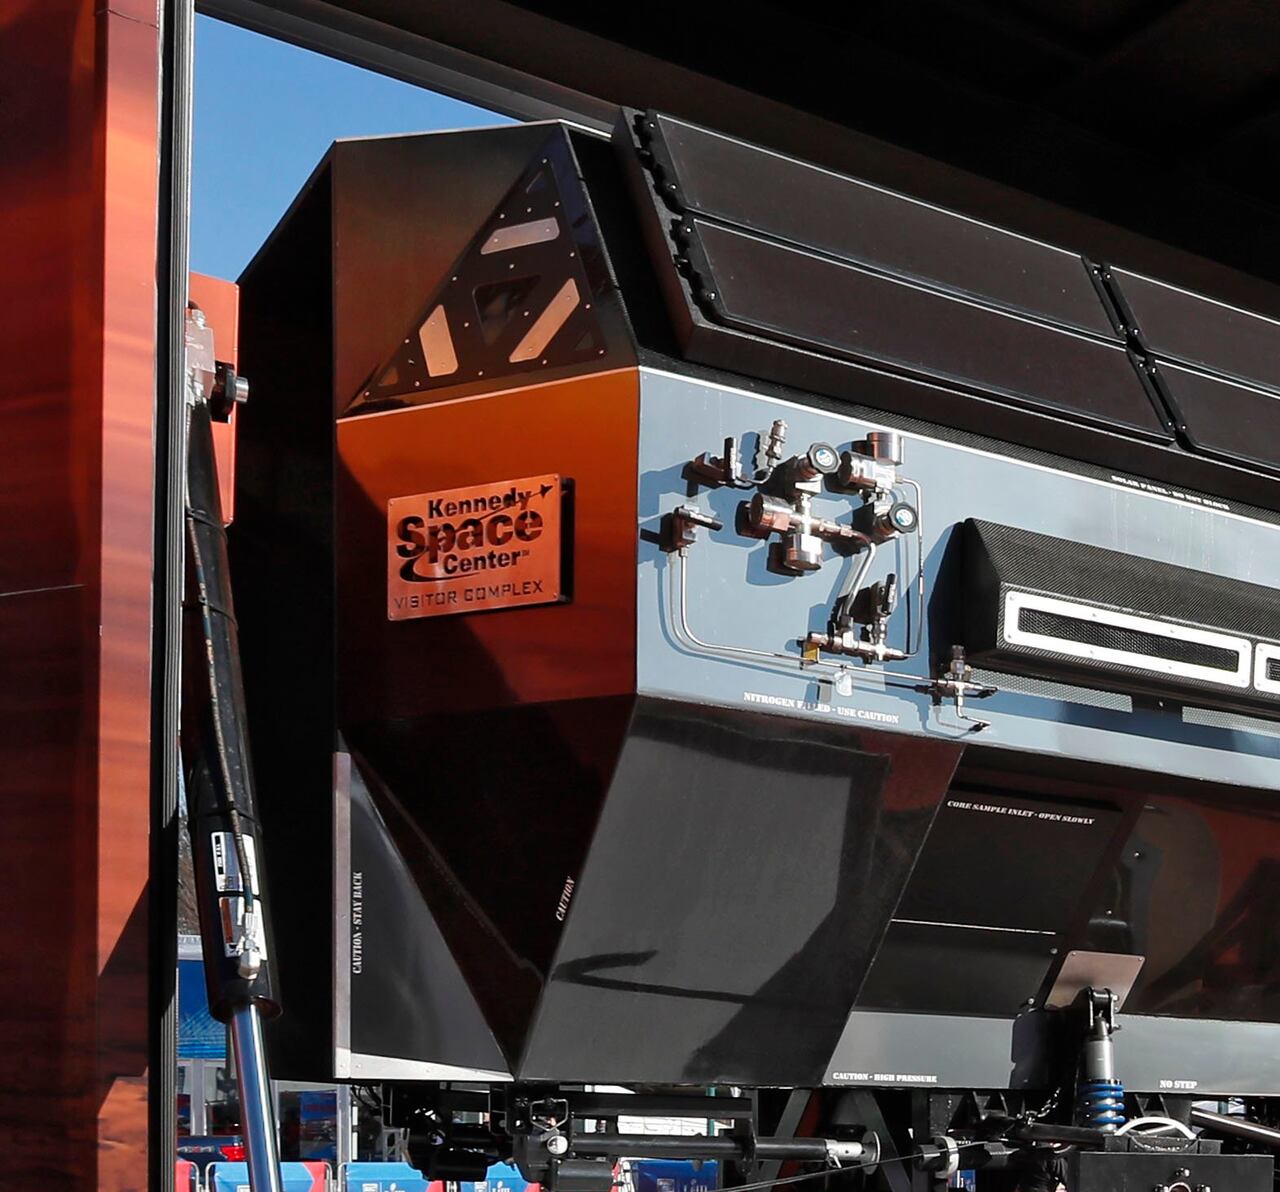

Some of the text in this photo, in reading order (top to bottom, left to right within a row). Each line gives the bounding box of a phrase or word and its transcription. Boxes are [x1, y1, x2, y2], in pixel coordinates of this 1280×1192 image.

[429, 487, 532, 519] Kennedy
[396, 510, 544, 564] Space
[443, 550, 522, 575] Center
[395, 580, 544, 609] VISITOR COMPLEX
[743, 692, 797, 708] NITROGEN
[837, 706, 856, 717] USE
[857, 710, 899, 723] CAUTION
[947, 800, 972, 810] CORE
[972, 803, 1008, 815] SAMPLE
[1008, 808, 1034, 818] INLET
[1038, 813, 1062, 822] OPEN
[1061, 815, 1095, 825] SLOWLY
[353, 872, 362, 899] BACK
[555, 875, 575, 921] CAUTION
[353, 900, 362, 925] STAY
[353, 932, 362, 974] CAUTION
[832, 1072, 869, 1081] CAUTION
[874, 1073, 895, 1081] HIGH
[896, 1074, 938, 1083] PRESSURE
[1160, 1080, 1198, 1089] NO STEP
